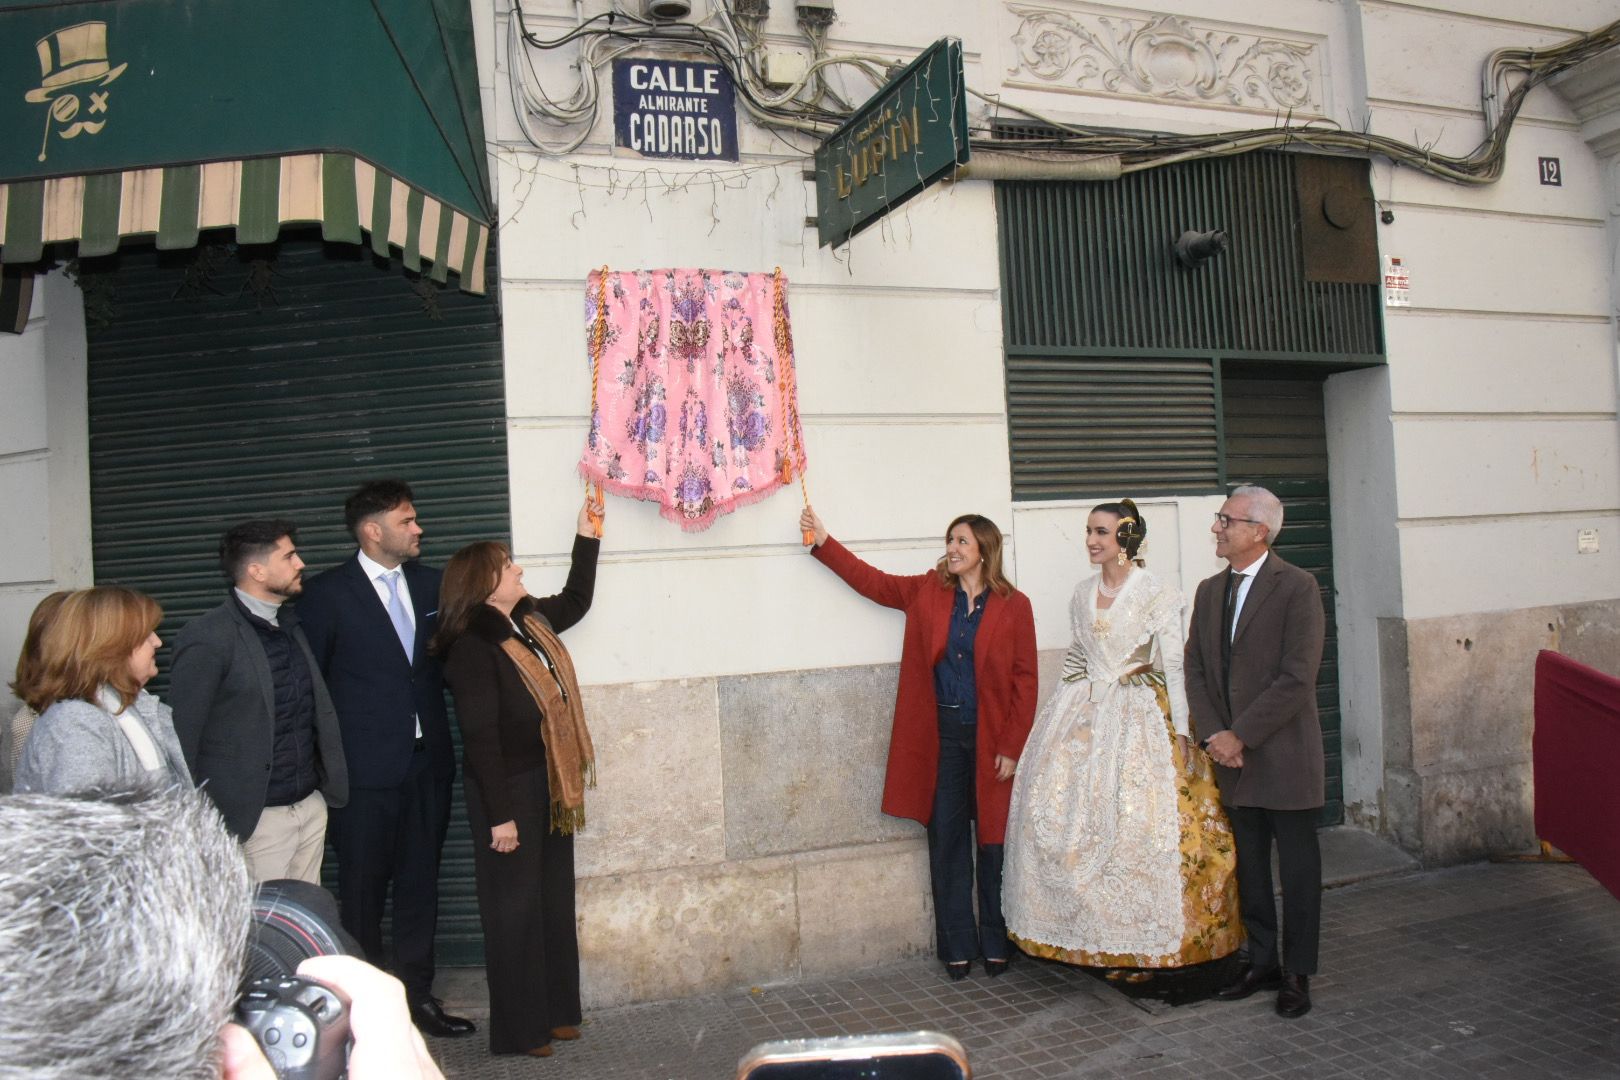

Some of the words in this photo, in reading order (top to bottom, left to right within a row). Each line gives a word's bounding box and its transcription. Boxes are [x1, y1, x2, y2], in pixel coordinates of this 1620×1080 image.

[630, 65, 720, 94] CALLE
[639, 95, 708, 113] ALMIRANTE
[630, 113, 722, 155] CADARSO
[837, 107, 919, 199] LUPIN
[1542, 160, 1558, 182] 12
